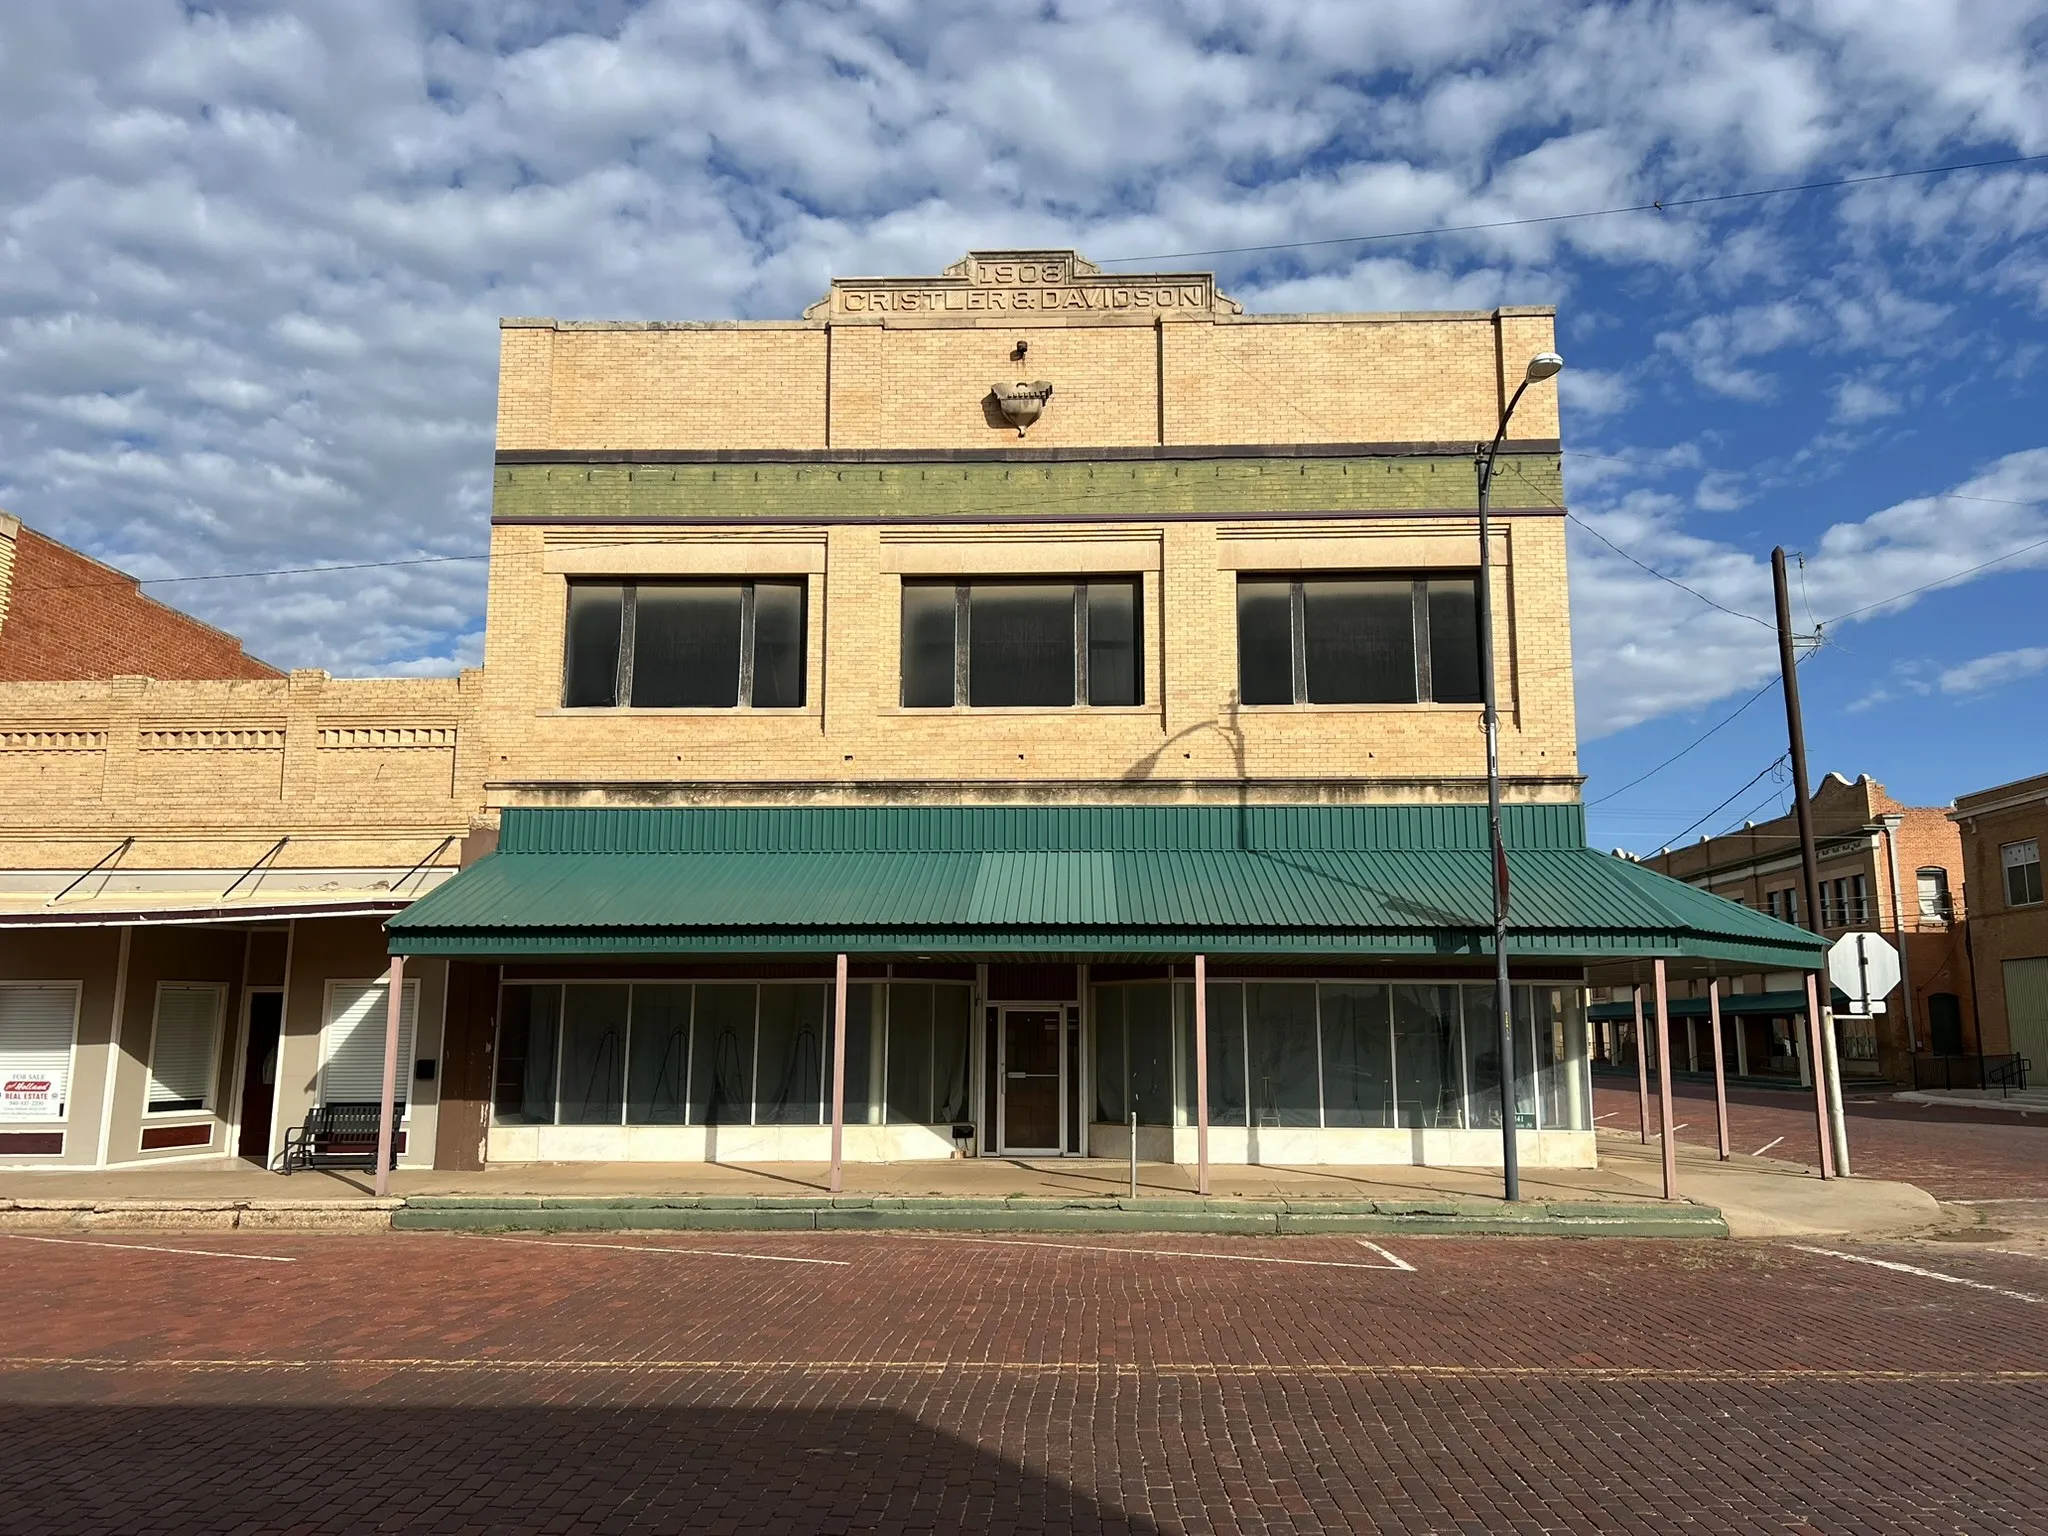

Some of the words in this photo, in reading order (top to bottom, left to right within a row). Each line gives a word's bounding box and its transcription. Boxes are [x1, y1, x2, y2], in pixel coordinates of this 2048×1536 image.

[979, 264, 1064, 285] 1908
[844, 290, 1006, 311] CRISTLER
[1012, 291, 1035, 310] &
[1041, 287, 1205, 310] DAVIDSON
